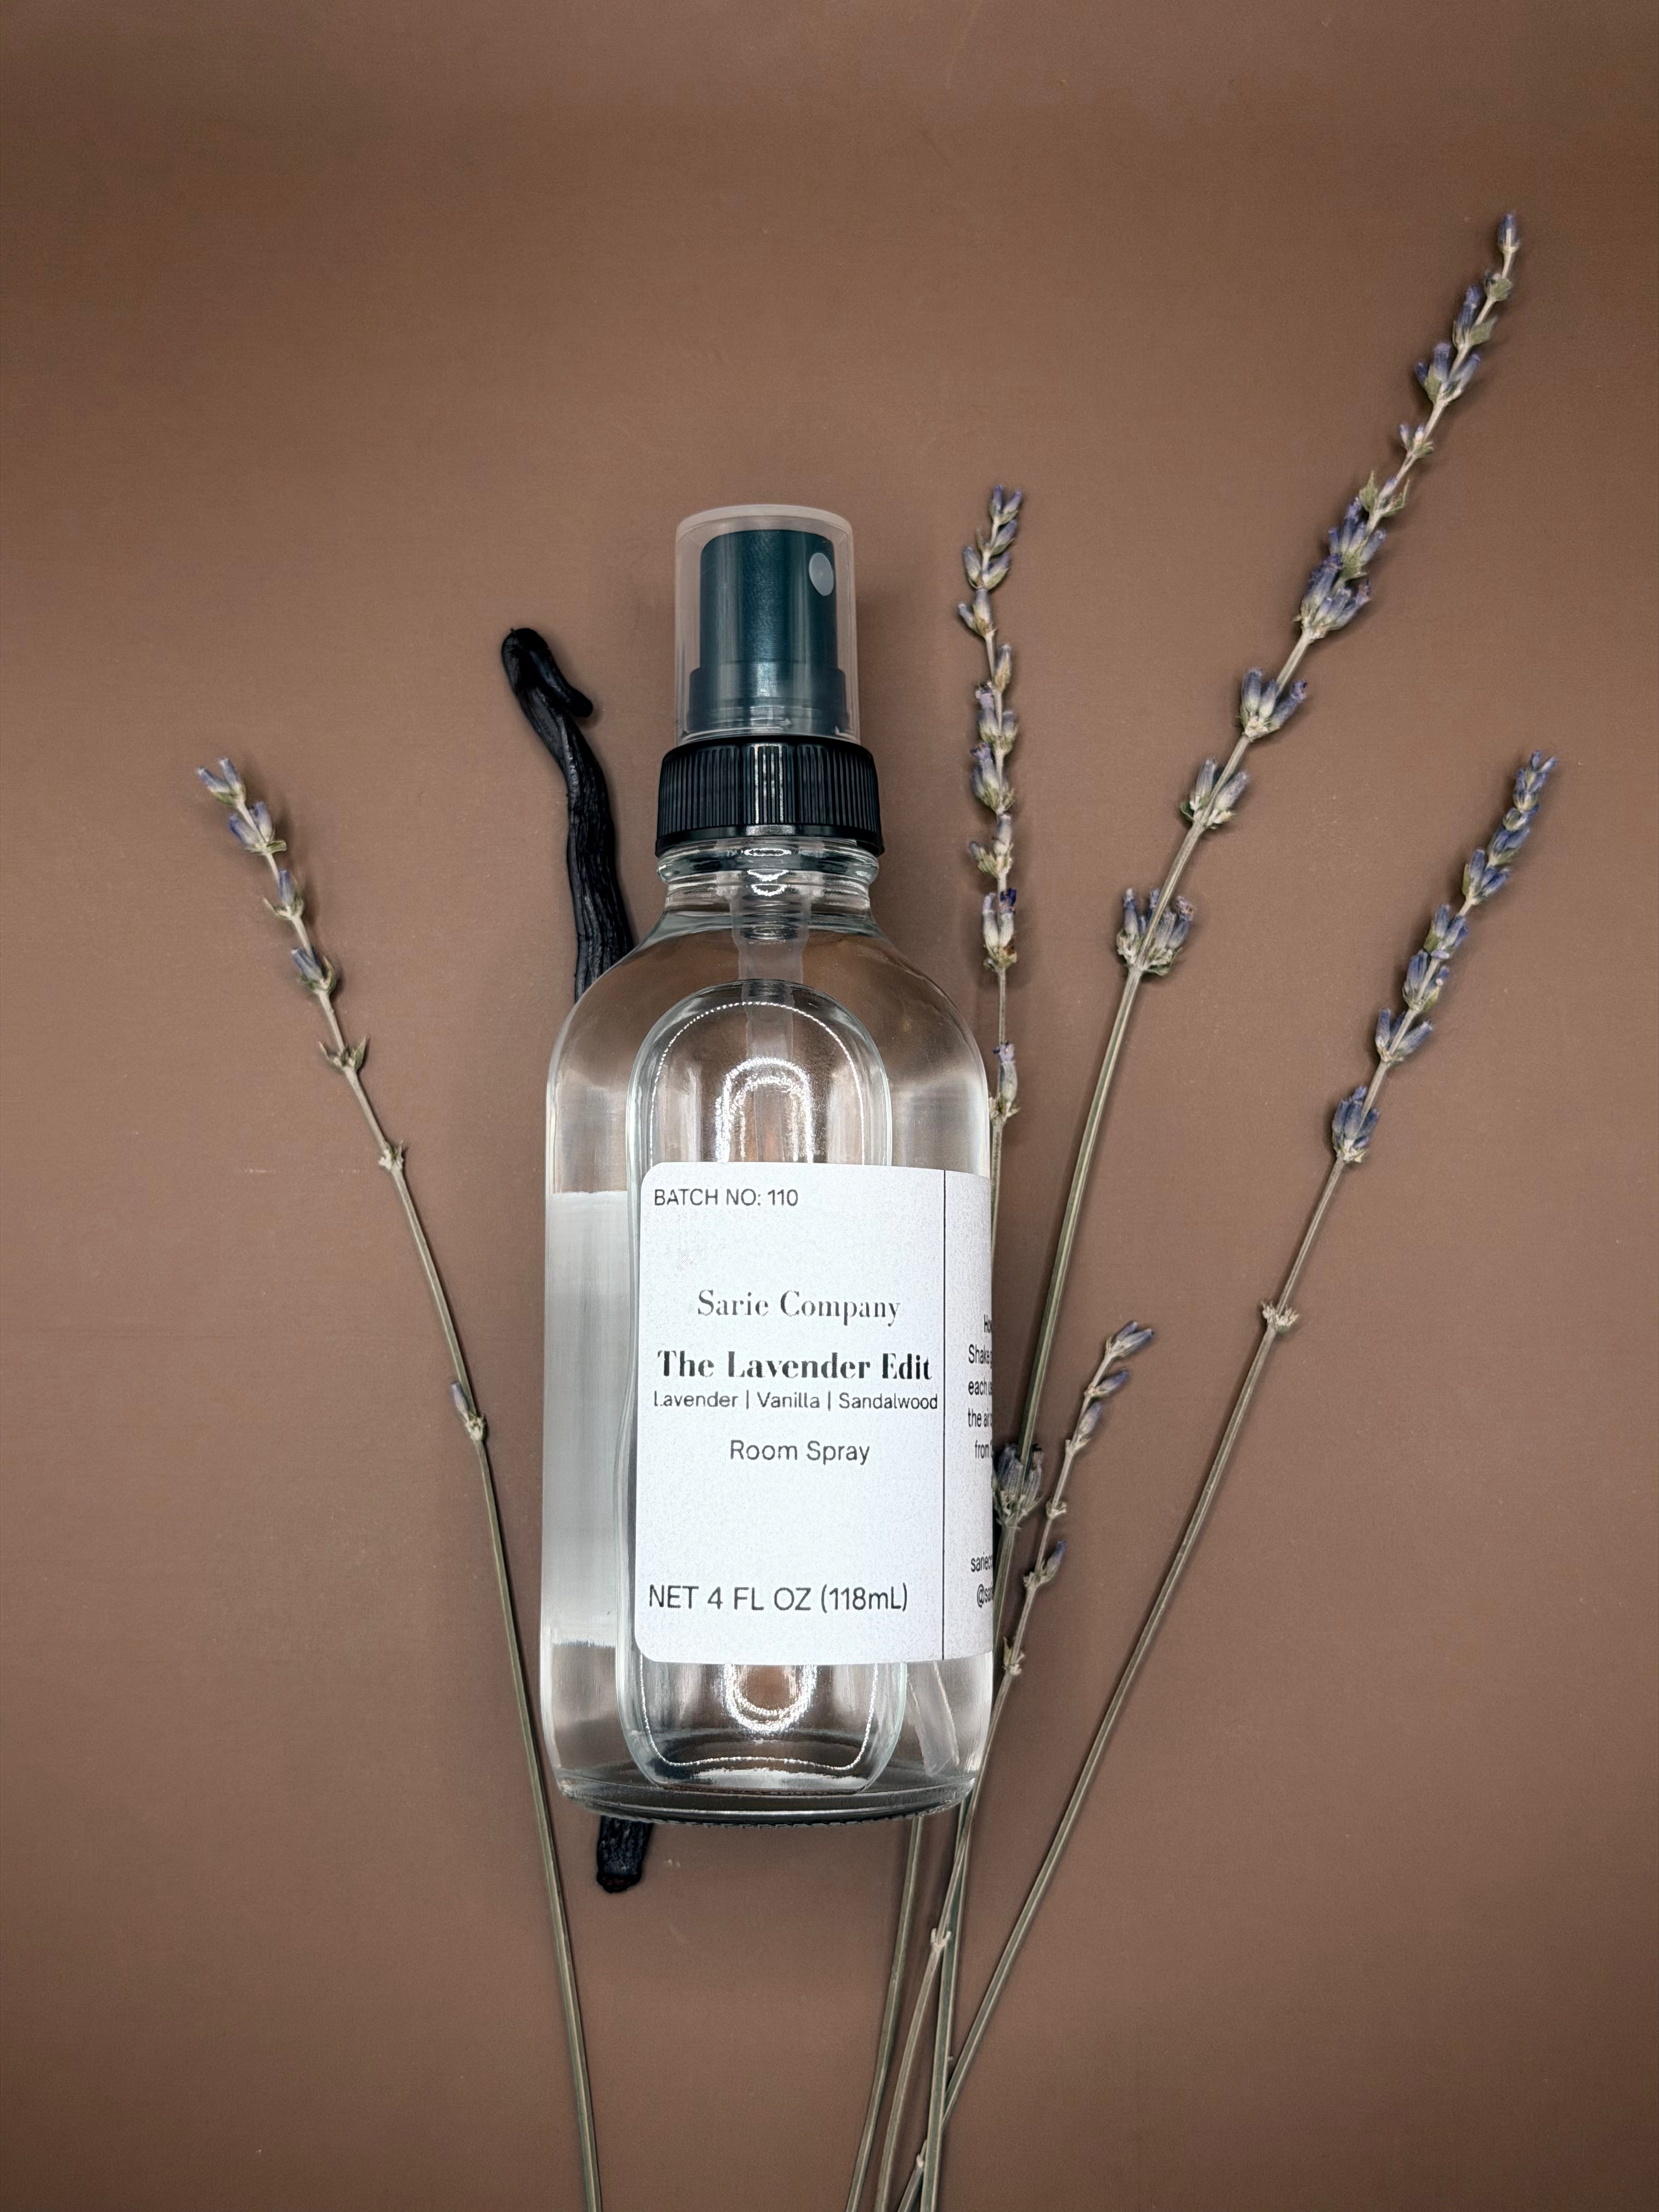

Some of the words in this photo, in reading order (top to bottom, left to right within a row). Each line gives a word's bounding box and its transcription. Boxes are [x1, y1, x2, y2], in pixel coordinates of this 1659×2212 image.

[654, 1188, 719, 1206] BATCH
[726, 1188, 761, 1206] NO:
[767, 1188, 799, 1207] 110
[697, 1289, 770, 1316] Sarie
[780, 1290, 900, 1328] Company
[968, 1343, 990, 1365] Shake
[657, 1350, 715, 1378] The
[727, 1350, 871, 1379] Lavender
[881, 1352, 933, 1381] Edit
[967, 1376, 988, 1396] each
[653, 1390, 739, 1408] Lavender
[757, 1391, 821, 1409] Vanilla
[838, 1392, 938, 1410] Sandalwood
[967, 1407, 983, 1427] the
[730, 1439, 798, 1461] Room
[806, 1440, 871, 1466] Spray
[648, 1584, 699, 1610] NET
[707, 1586, 724, 1610] 4
[733, 1586, 765, 1611] FL
[774, 1587, 812, 1612] OZ
[820, 1582, 908, 1614] (118mL)
